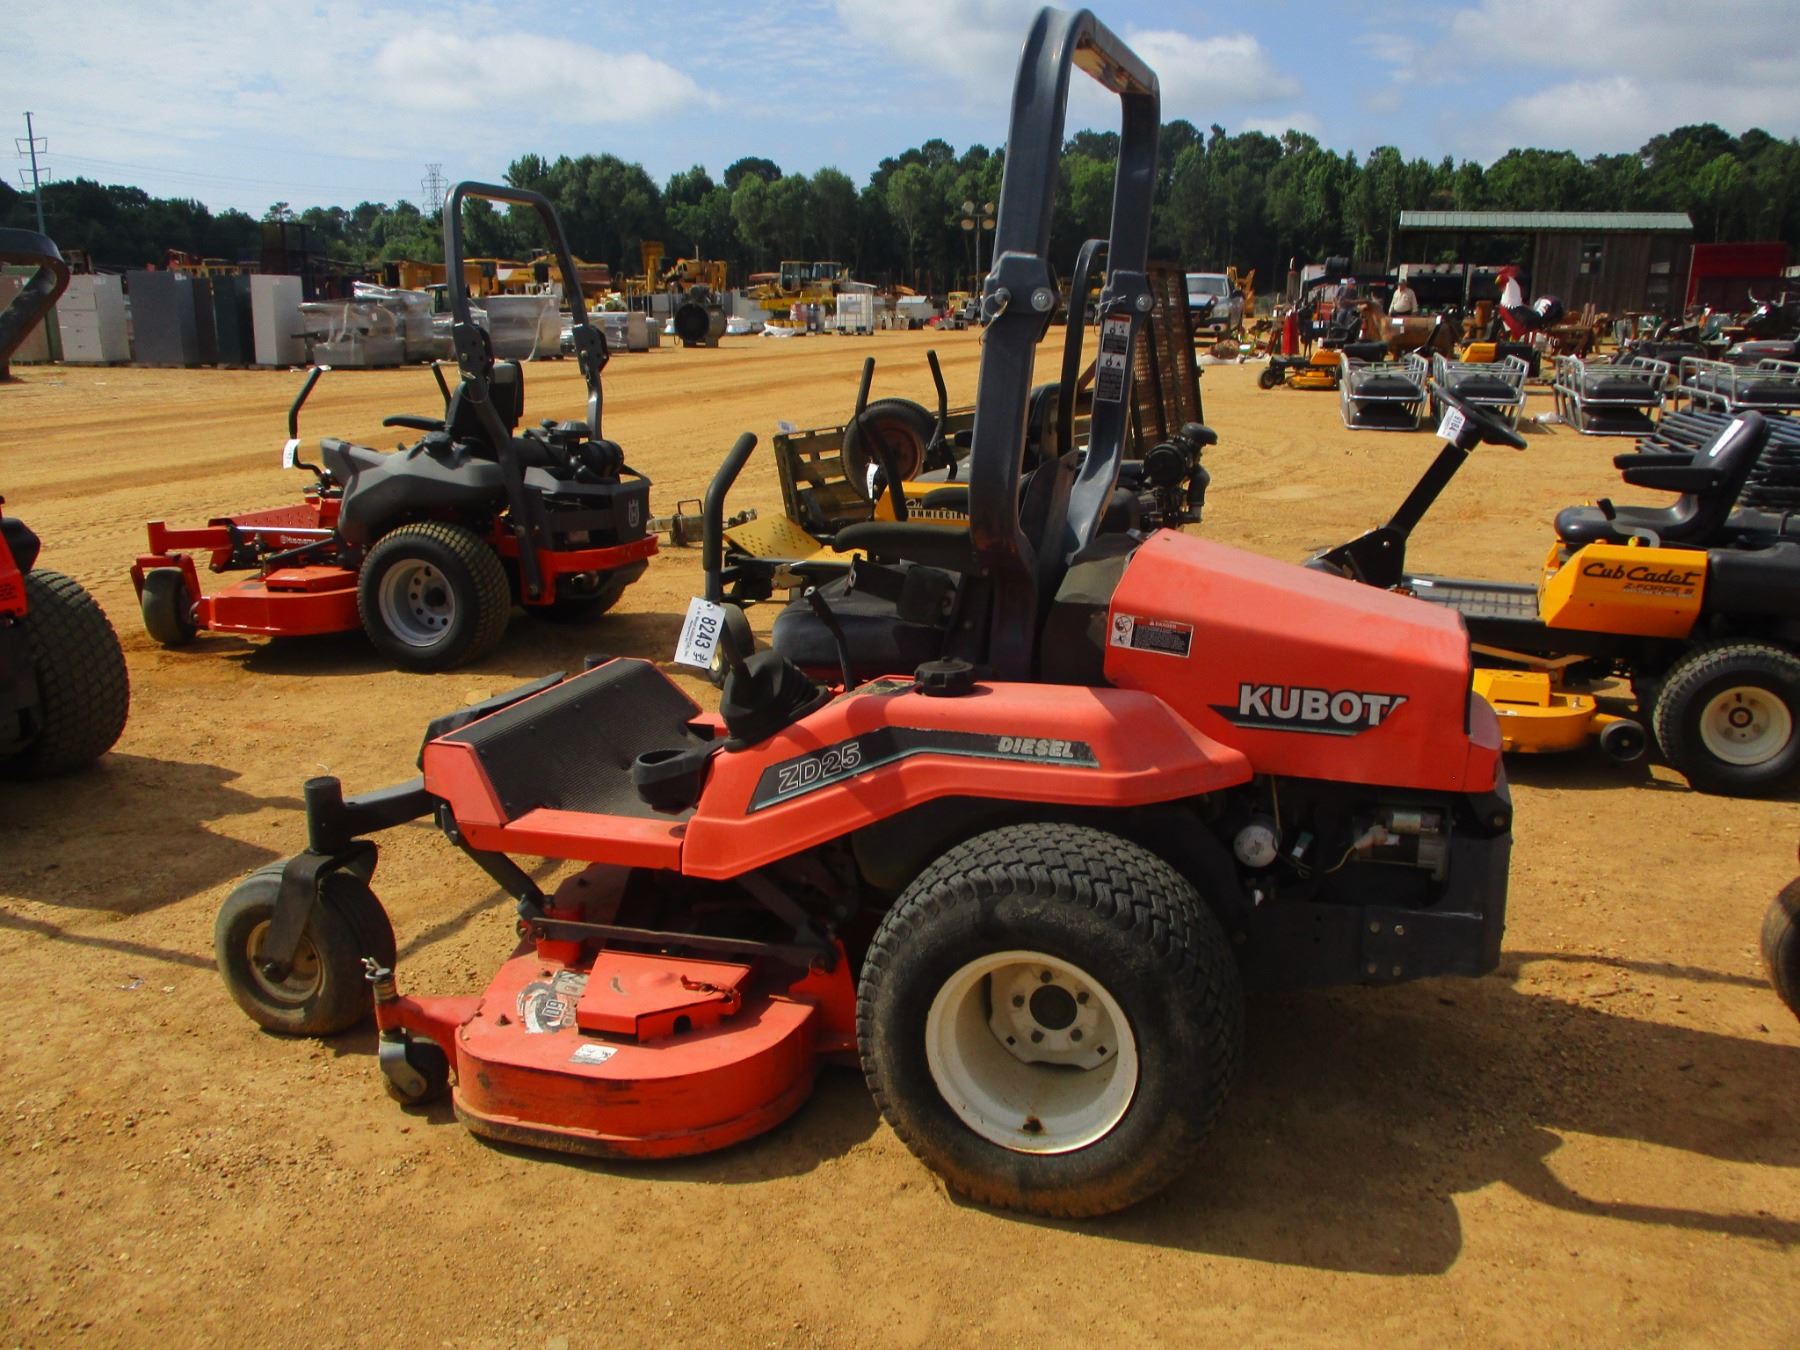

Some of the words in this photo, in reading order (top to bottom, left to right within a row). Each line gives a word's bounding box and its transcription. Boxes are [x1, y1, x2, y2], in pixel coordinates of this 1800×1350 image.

[1583, 562, 1625, 580] Cub
[1626, 566, 1702, 587] Cadet
[694, 616, 717, 649] 8243
[778, 743, 861, 793] ZD25
[997, 736, 1074, 759] DIESEL
